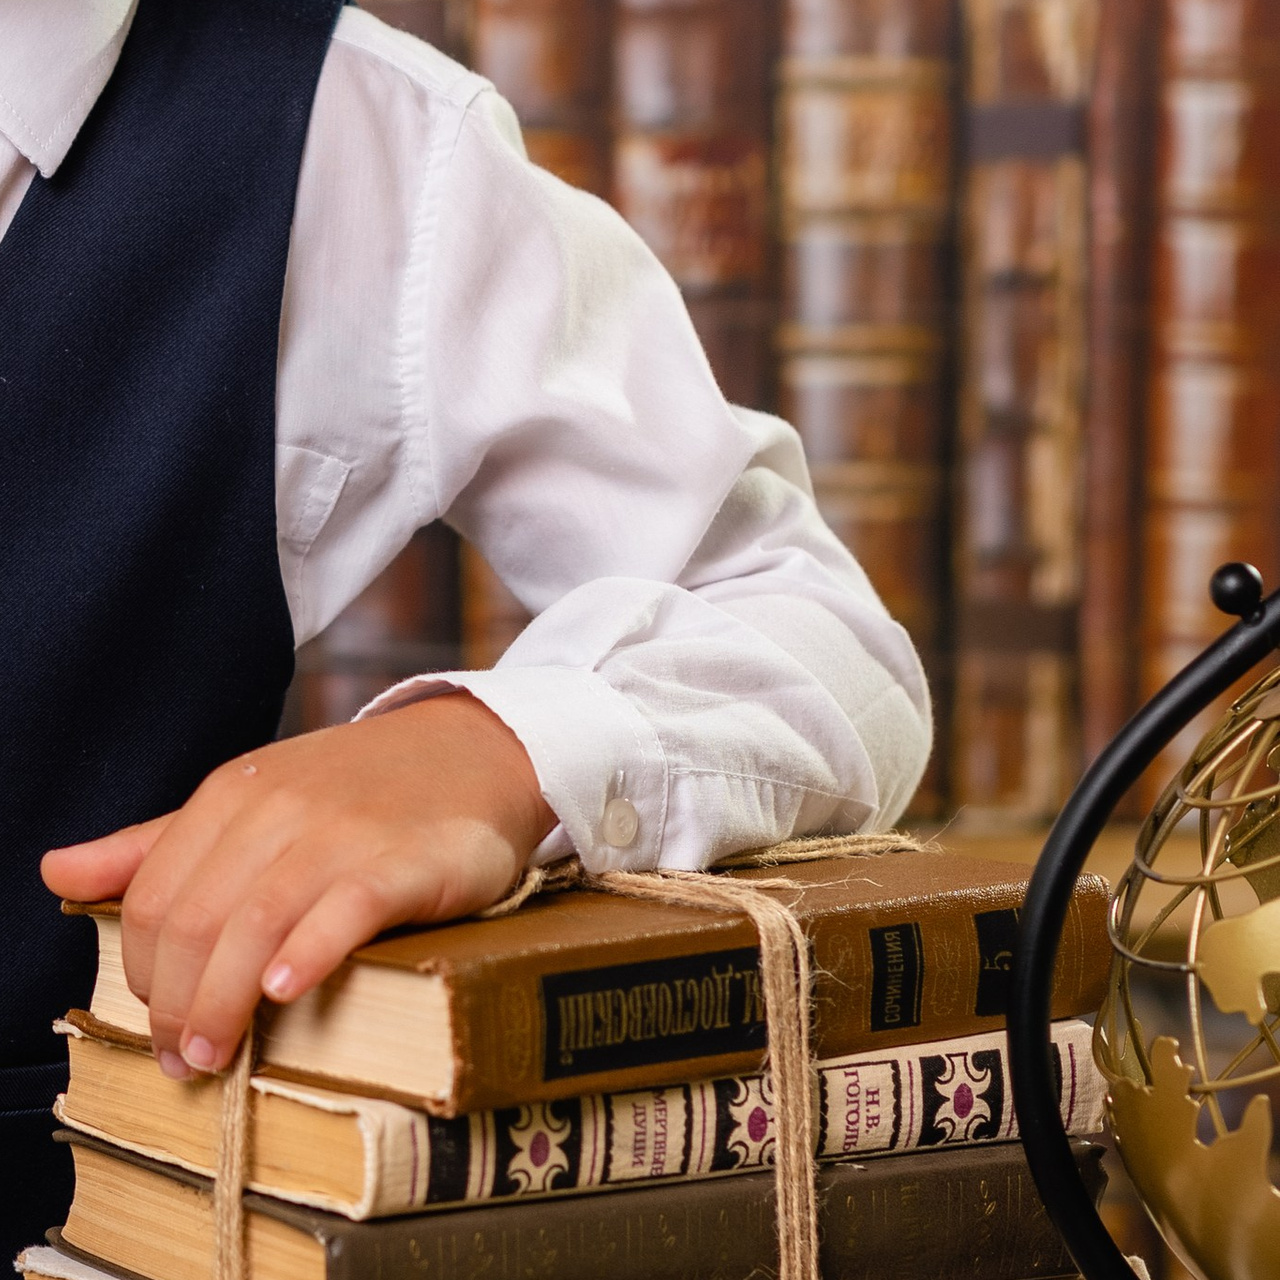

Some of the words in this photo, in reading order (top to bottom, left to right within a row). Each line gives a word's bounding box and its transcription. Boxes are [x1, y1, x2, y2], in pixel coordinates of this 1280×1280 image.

[883, 929, 905, 1024] СОЧИНЕНИЯ
[983, 949, 1013, 972] 5
[630, 1102, 648, 1168] ДУШИ
[650, 1089, 669, 1179] МЕРТВЫЕ
[842, 1069, 861, 1153] ГОГОЛЬ
[864, 1088, 881, 1135] Н.В.
